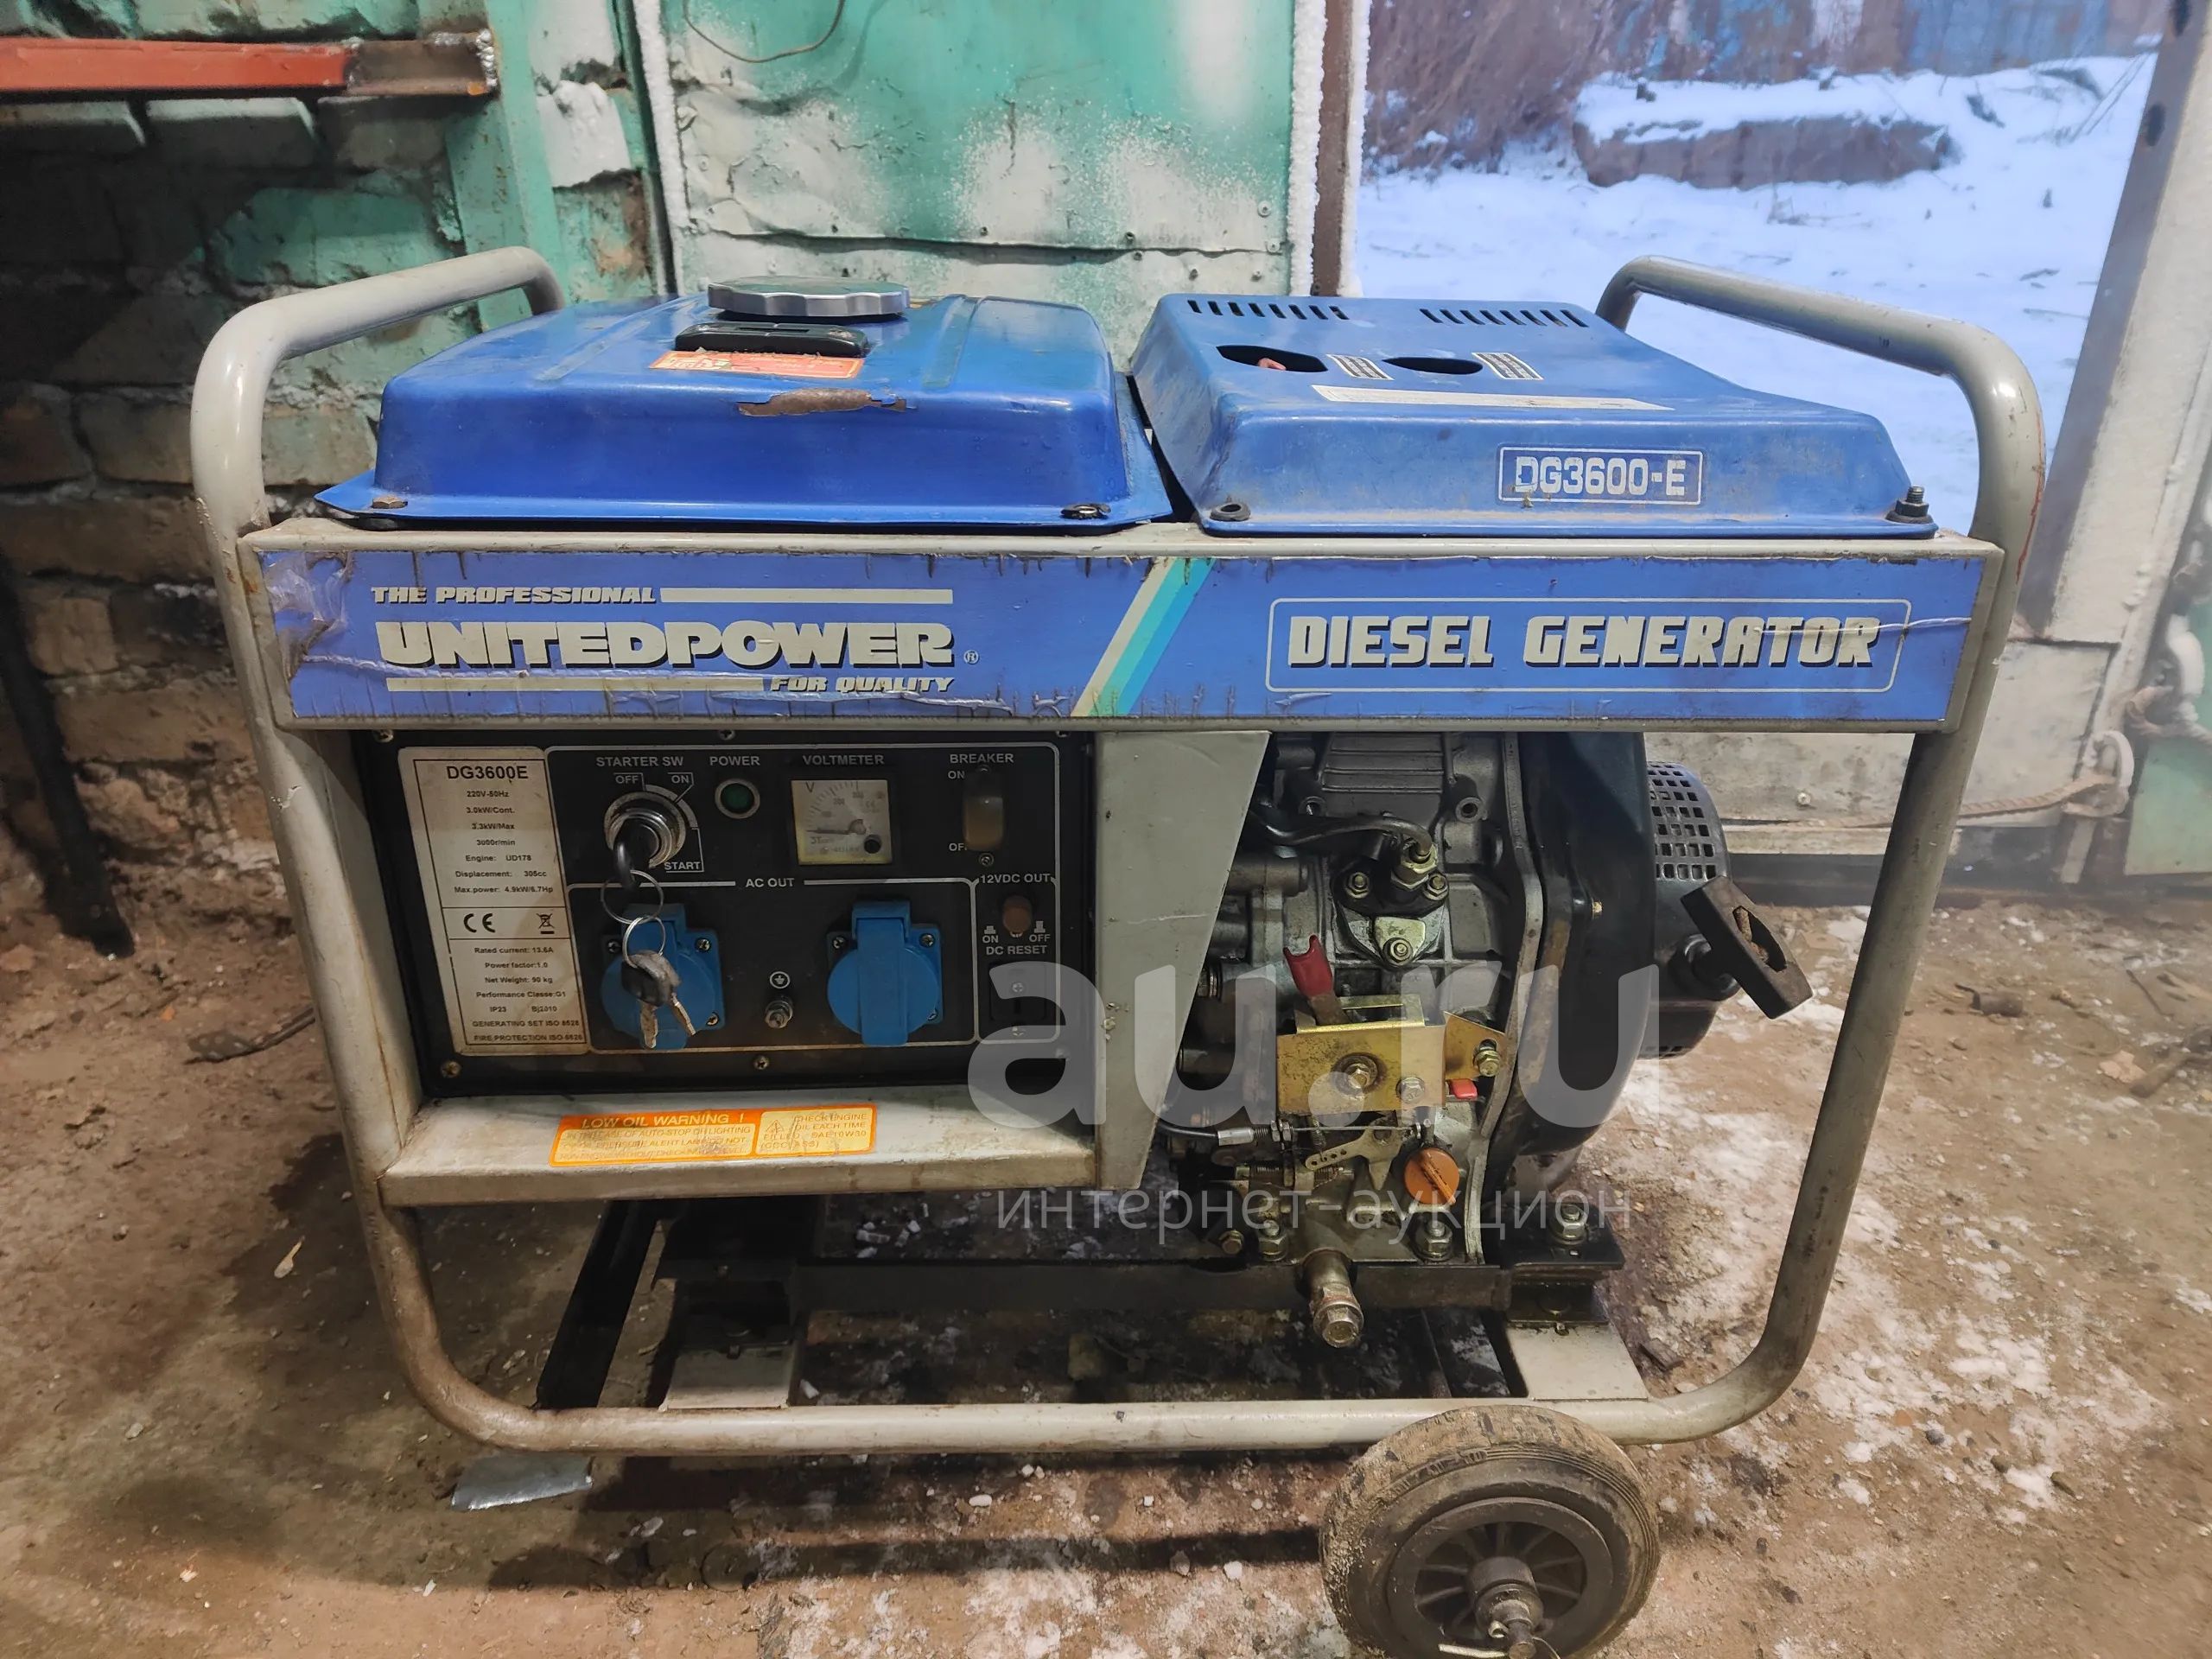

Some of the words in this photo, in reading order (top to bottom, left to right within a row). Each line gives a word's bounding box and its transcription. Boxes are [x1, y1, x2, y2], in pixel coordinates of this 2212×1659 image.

[1514, 455, 1688, 497] DG3600-E
[371, 586, 427, 604] THE
[435, 586, 657, 604] PROFESSIONAL
[375, 620, 955, 670] UNITEDPOWER
[1287, 614, 1494, 669] DIESEL
[1522, 615, 1881, 669] GENERATOR
[770, 677, 828, 692] FOR
[835, 677, 955, 692] QUALITY
[595, 757, 658, 767] STARTER
[662, 757, 684, 767] SW
[709, 756, 760, 766] POWER
[802, 754, 885, 766] VOLTMETER
[950, 753, 1014, 764] BREAKER
[447, 765, 529, 780] DG3600E
[948, 770, 965, 779] ON
[615, 775, 639, 785] OFF
[671, 775, 690, 785] ON
[949, 842, 968, 852] OF
[465, 855, 497, 863] Engine:
[505, 854, 532, 862] UD178
[664, 861, 701, 871] START
[454, 870, 512, 879] Displacement:
[981, 874, 1020, 884] 12VDC
[1024, 873, 1051, 883] OUT
[746, 879, 765, 888] AC
[768, 878, 795, 887] OUT
[982, 935, 999, 944] ON
[1028, 934, 1051, 943] OFF
[986, 946, 1004, 955] DC
[1007, 944, 1047, 955] RESET
[499, 976, 531, 985] Weight:
[582, 1117, 620, 1128] LOW
[622, 1116, 649, 1127] OIL
[653, 1114, 729, 1126] WARNING
